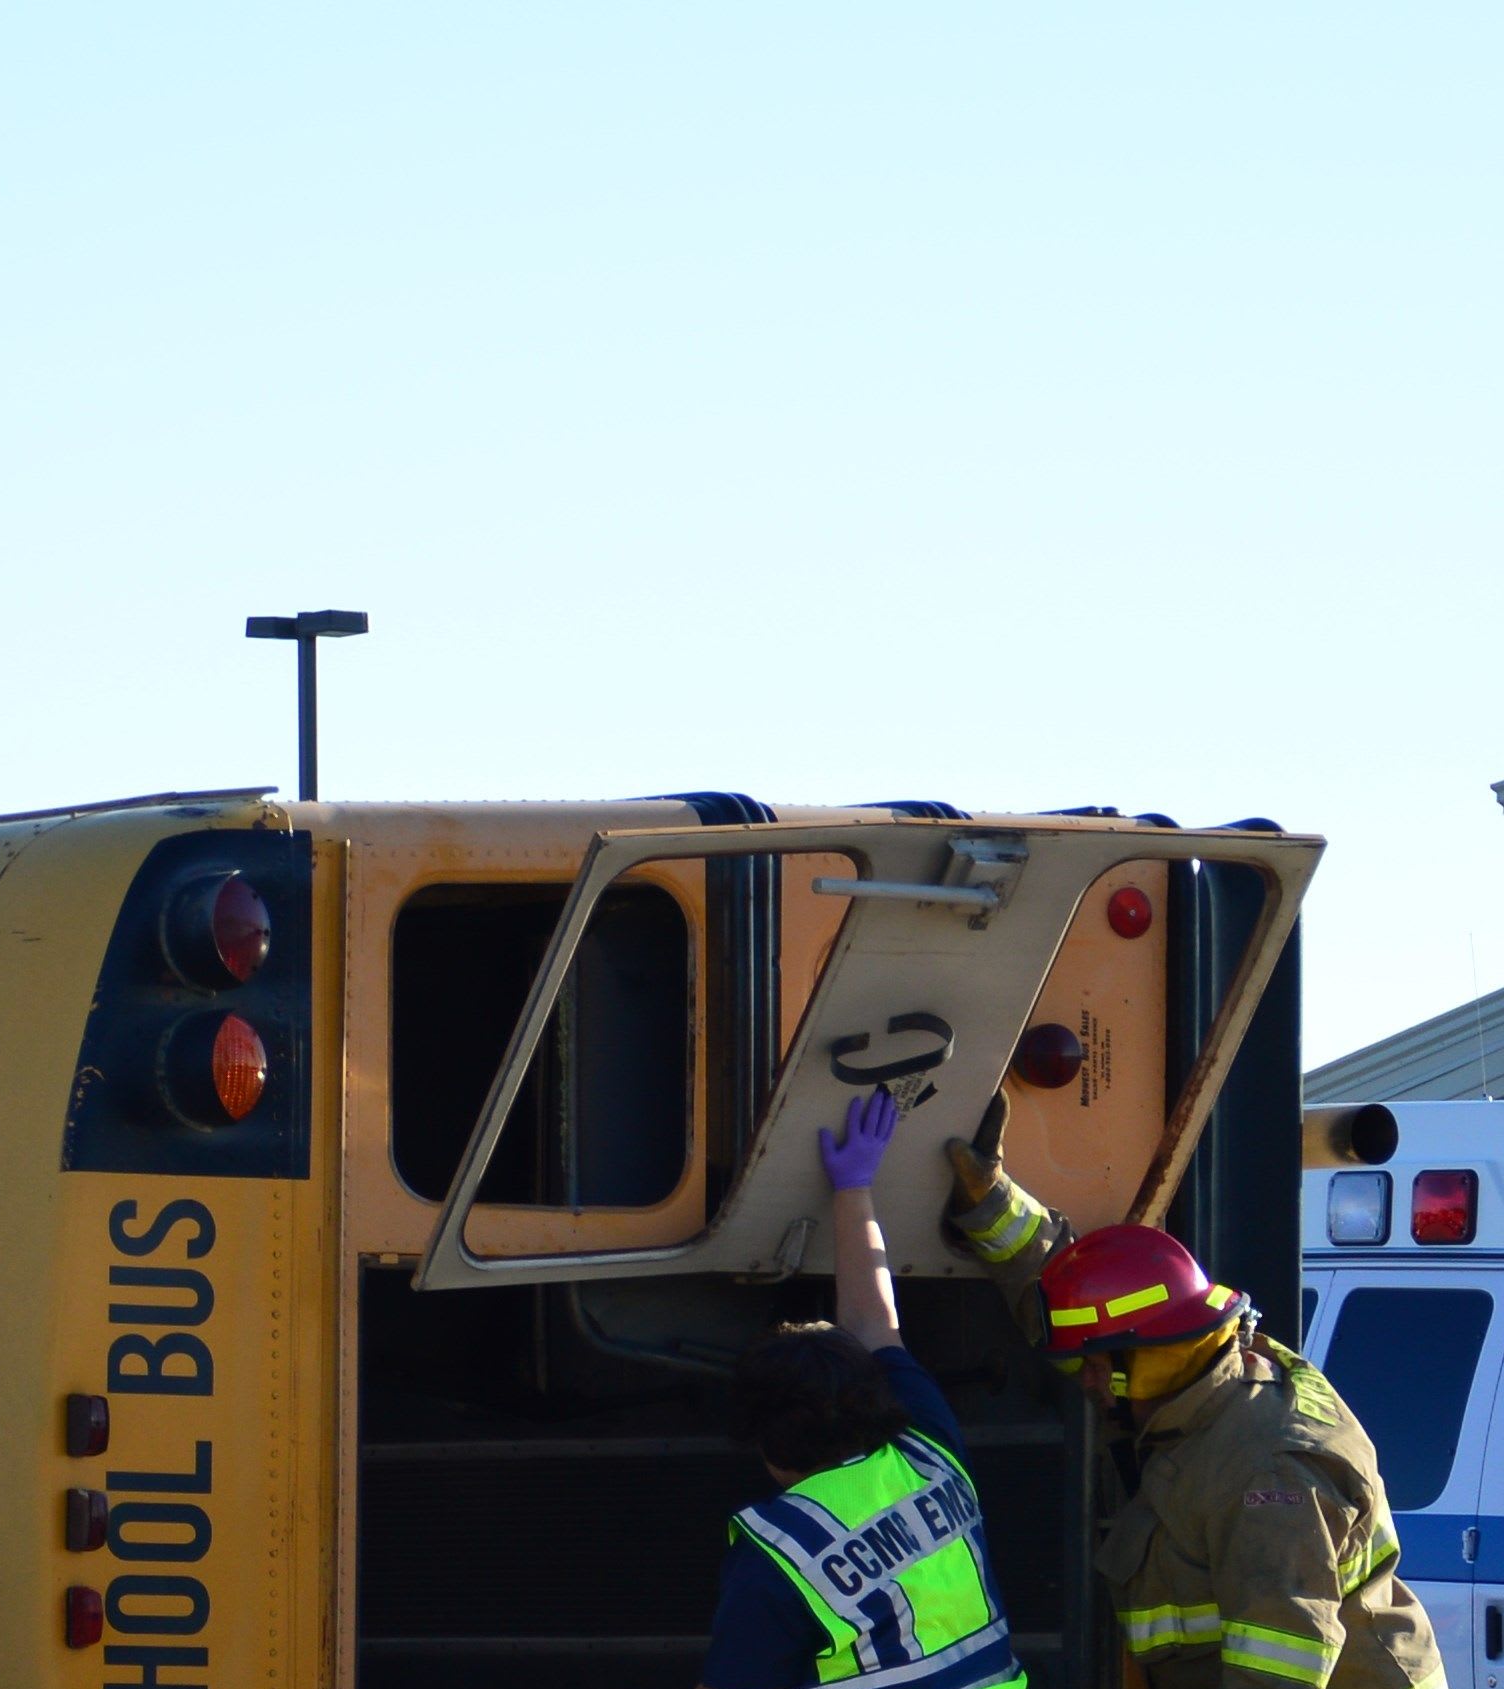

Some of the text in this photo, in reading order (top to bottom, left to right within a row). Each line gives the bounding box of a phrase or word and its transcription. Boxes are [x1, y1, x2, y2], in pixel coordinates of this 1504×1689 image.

[105, 1198, 218, 1398] BUS
[821, 1474, 977, 1597] CCMC EMS
